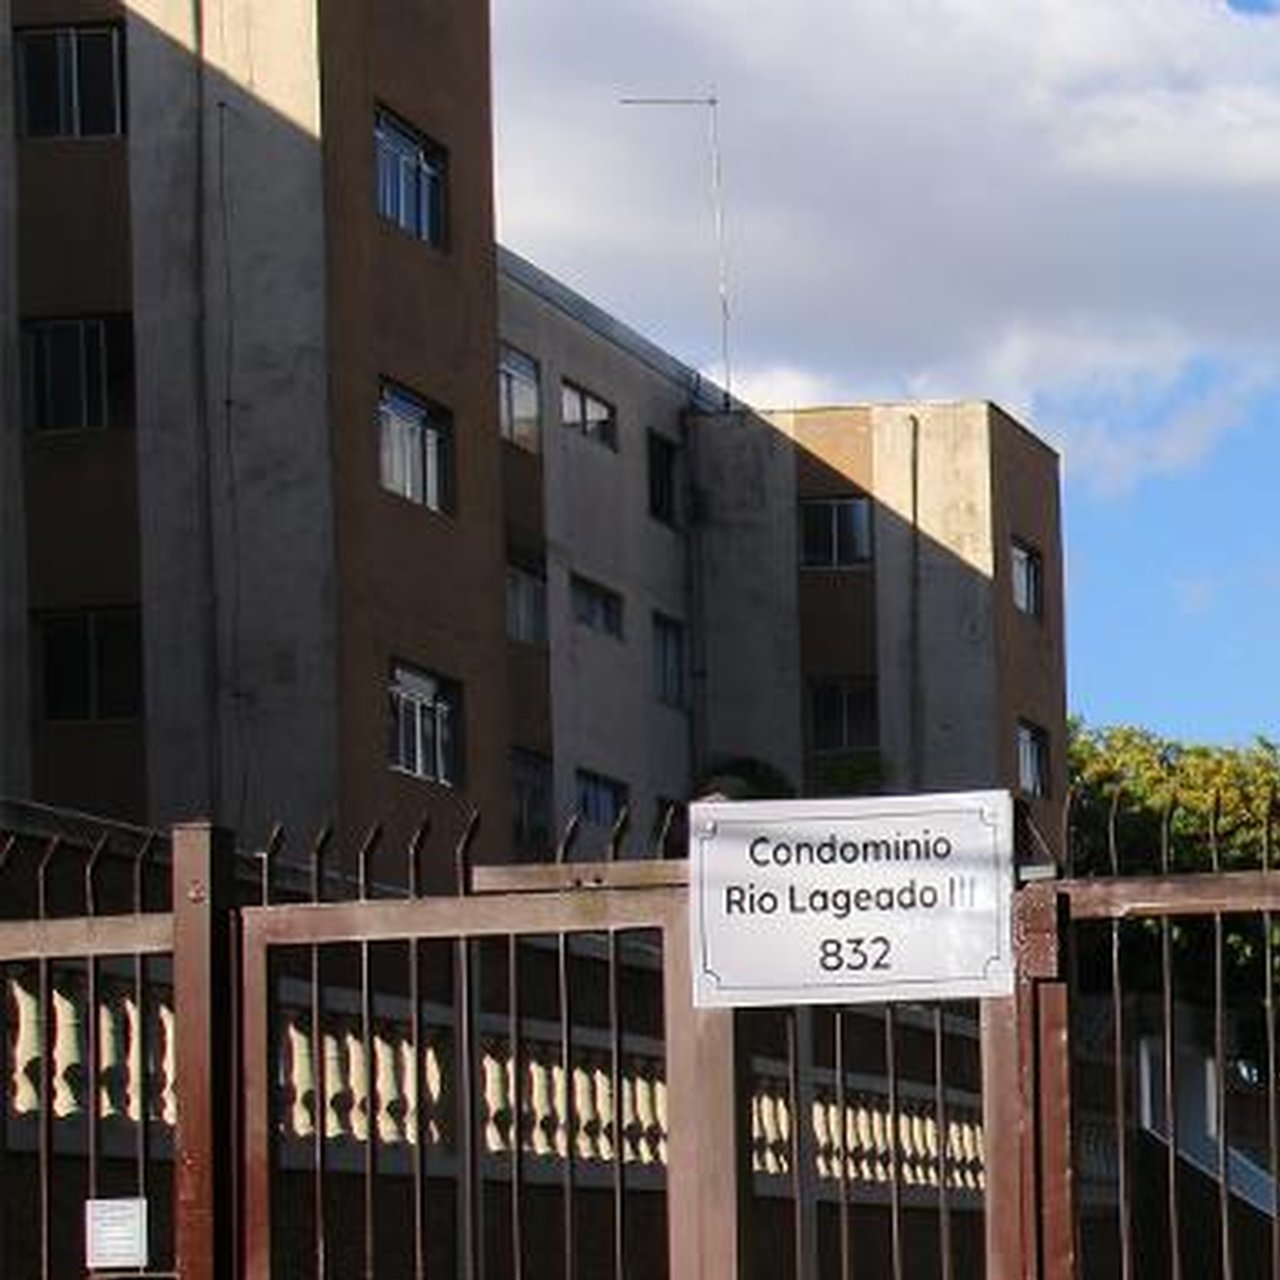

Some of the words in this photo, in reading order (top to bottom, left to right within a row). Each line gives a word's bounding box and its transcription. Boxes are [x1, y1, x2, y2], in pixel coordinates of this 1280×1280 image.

[748, 830, 952, 868] Condominio
[724, 883, 778, 915] Rio
[788, 879, 939, 919] Lageado
[819, 935, 892, 972] 832
